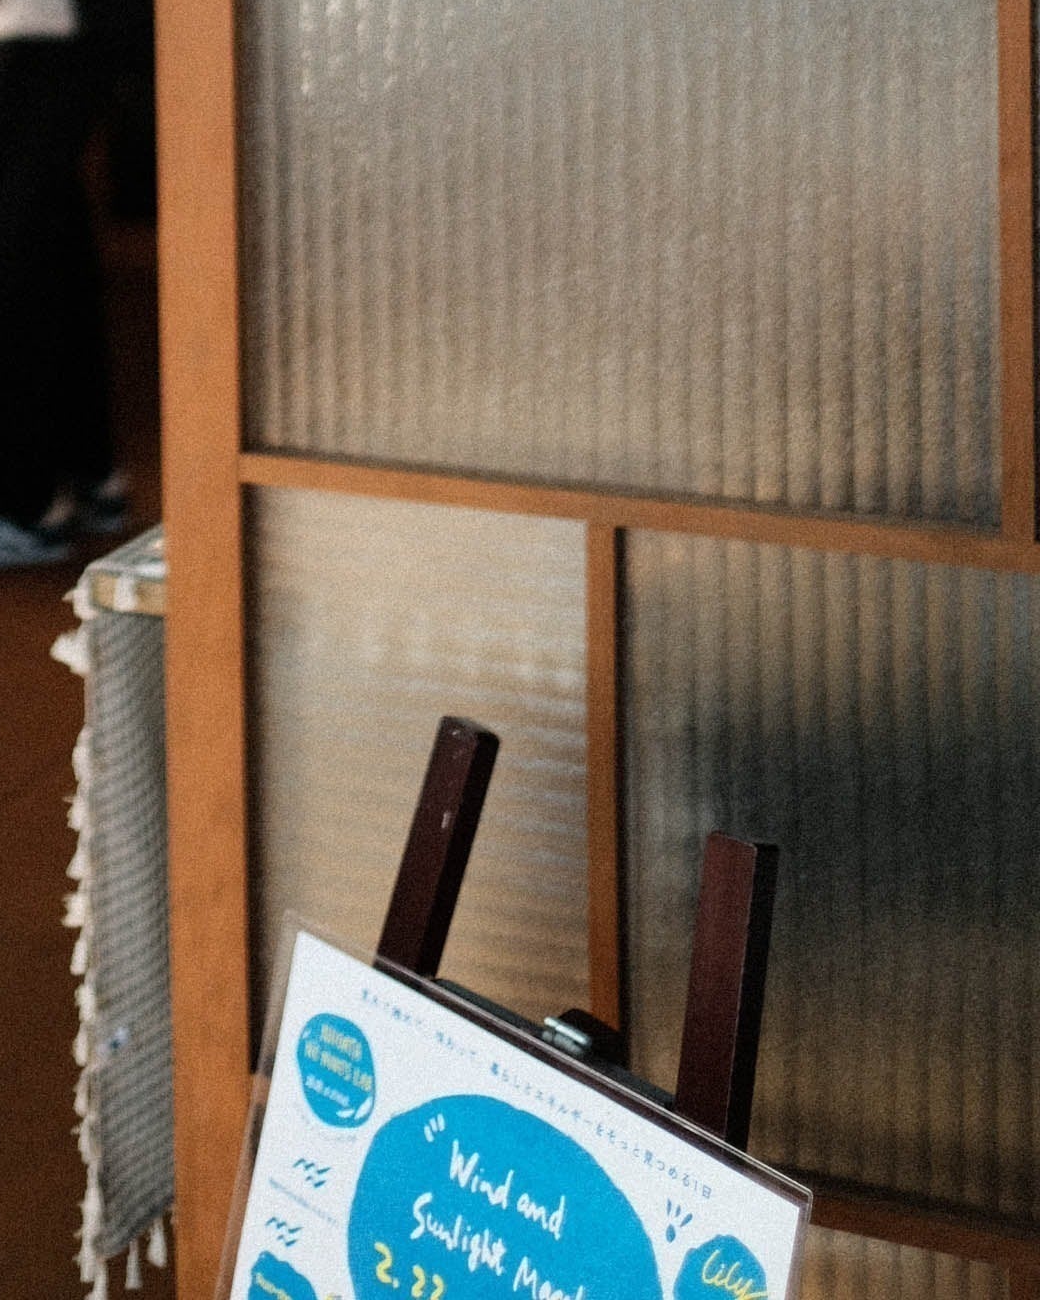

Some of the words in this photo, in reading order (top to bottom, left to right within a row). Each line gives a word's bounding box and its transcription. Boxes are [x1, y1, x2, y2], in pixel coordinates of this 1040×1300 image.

[410, 1192, 507, 1277] Sunlight
[449, 1138, 514, 1211] Wind
[515, 1193, 566, 1241] and
